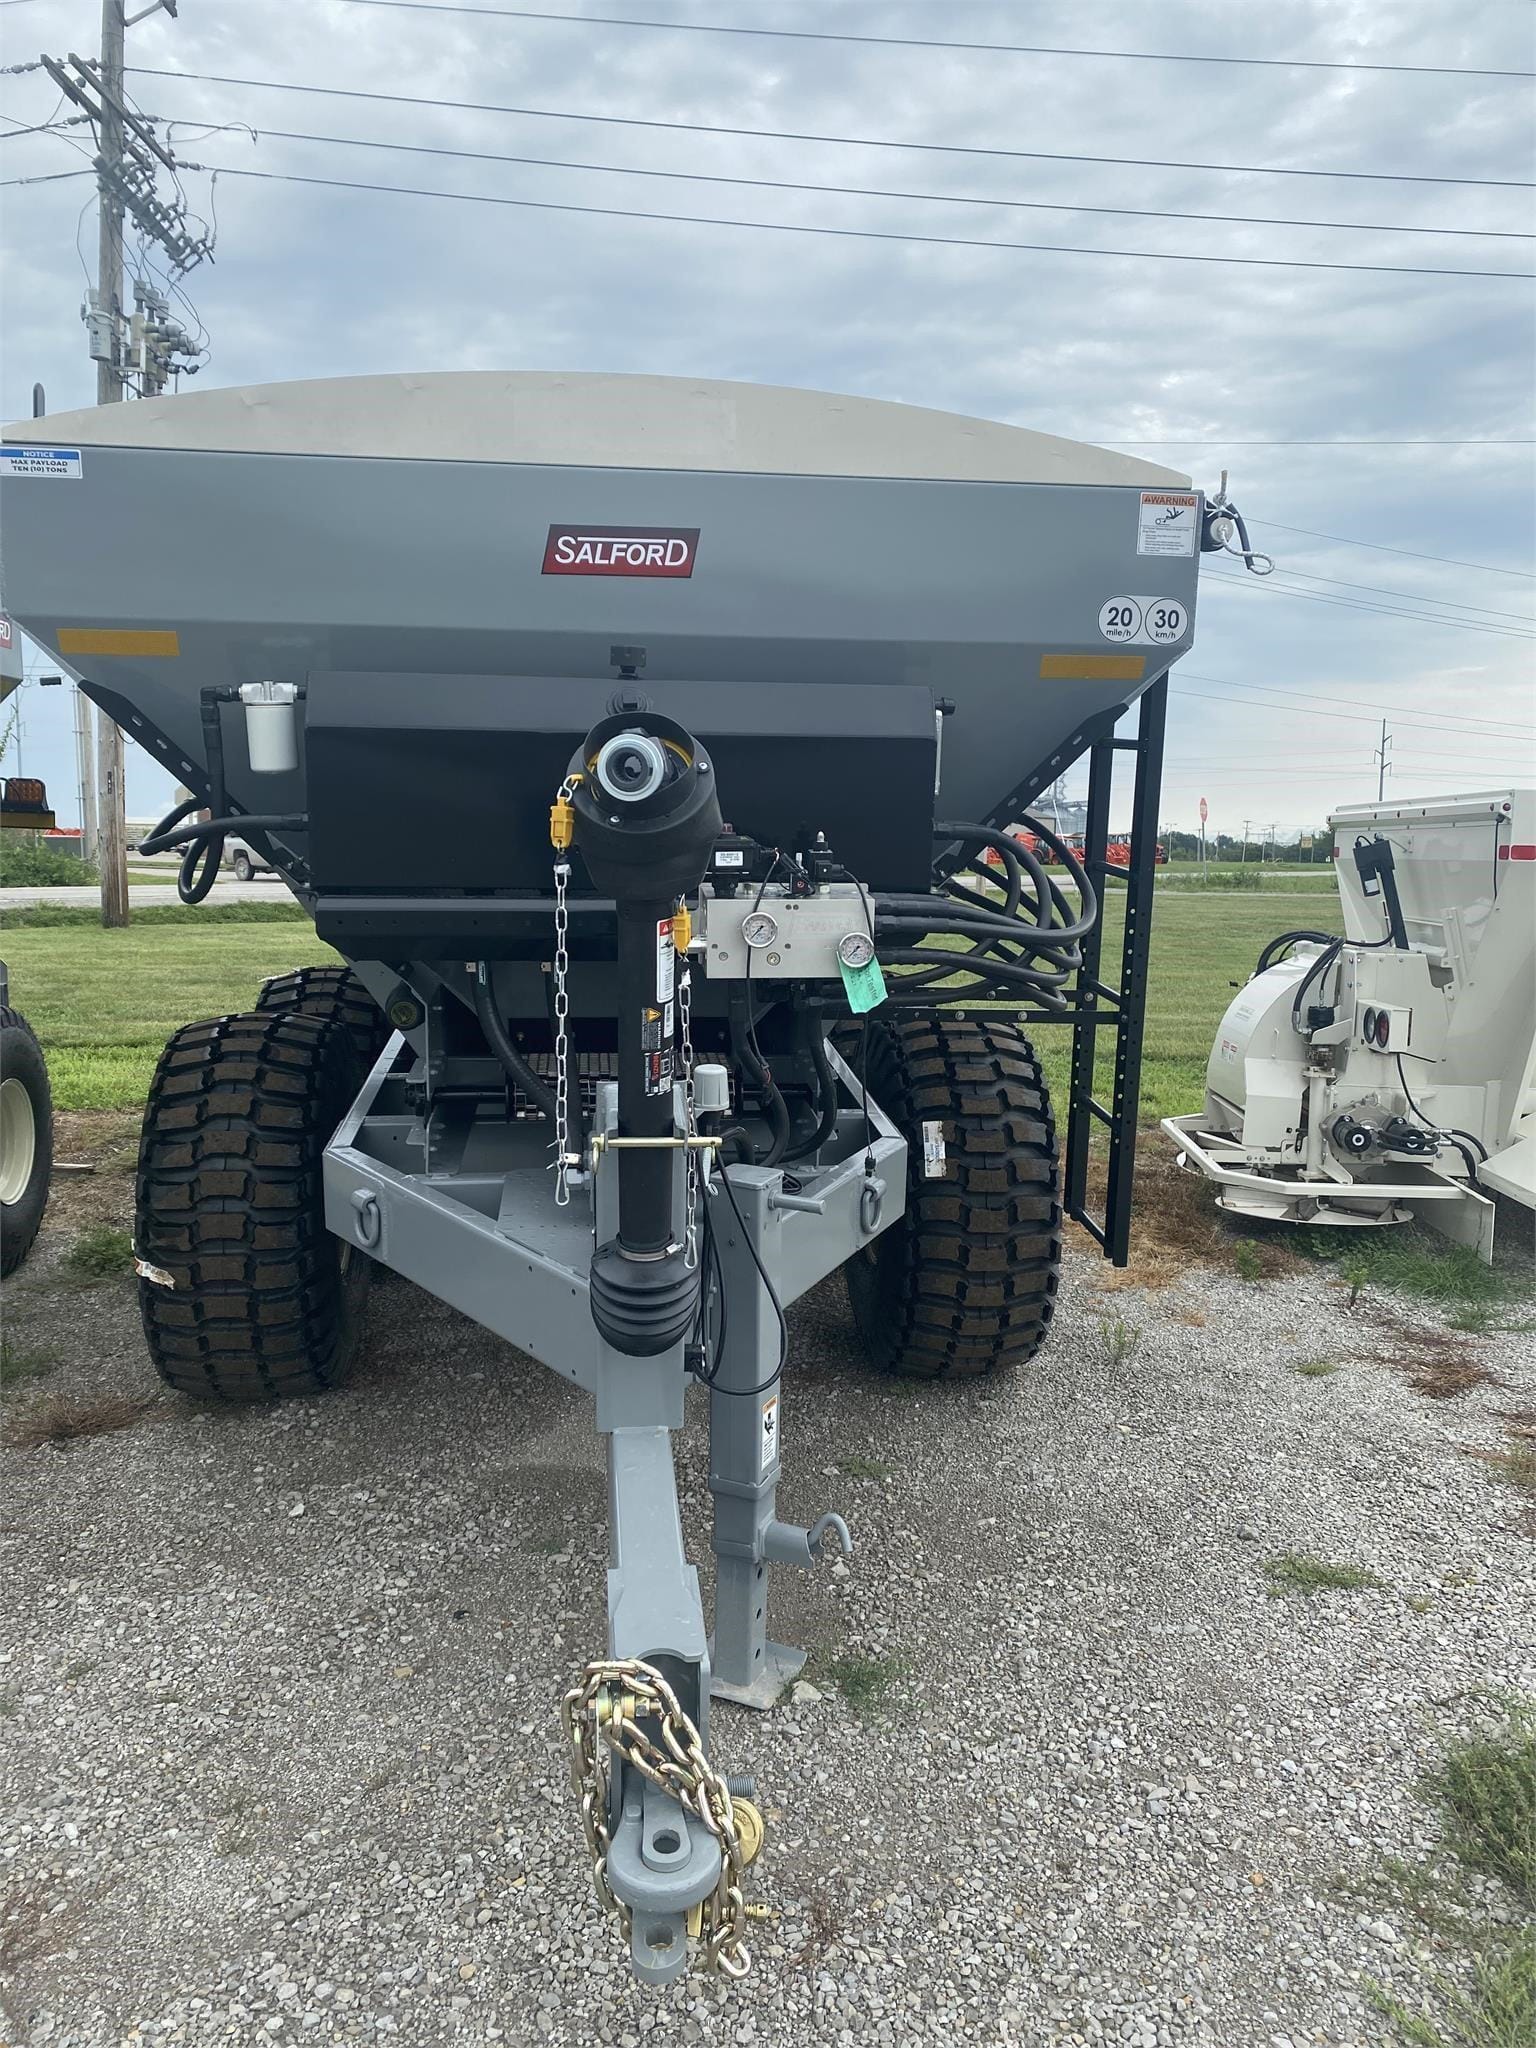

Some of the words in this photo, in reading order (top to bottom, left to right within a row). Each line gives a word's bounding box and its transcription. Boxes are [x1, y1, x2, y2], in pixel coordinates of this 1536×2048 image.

[22, 450, 55, 458] NOTICE
[1151, 495, 1195, 506] WARNING
[554, 535, 689, 567] SALFORD
[1106, 606, 1133, 627] 20
[1154, 609, 1180, 629] 30
[1106, 629, 1132, 638] mile/h
[1155, 631, 1176, 639] km/h
